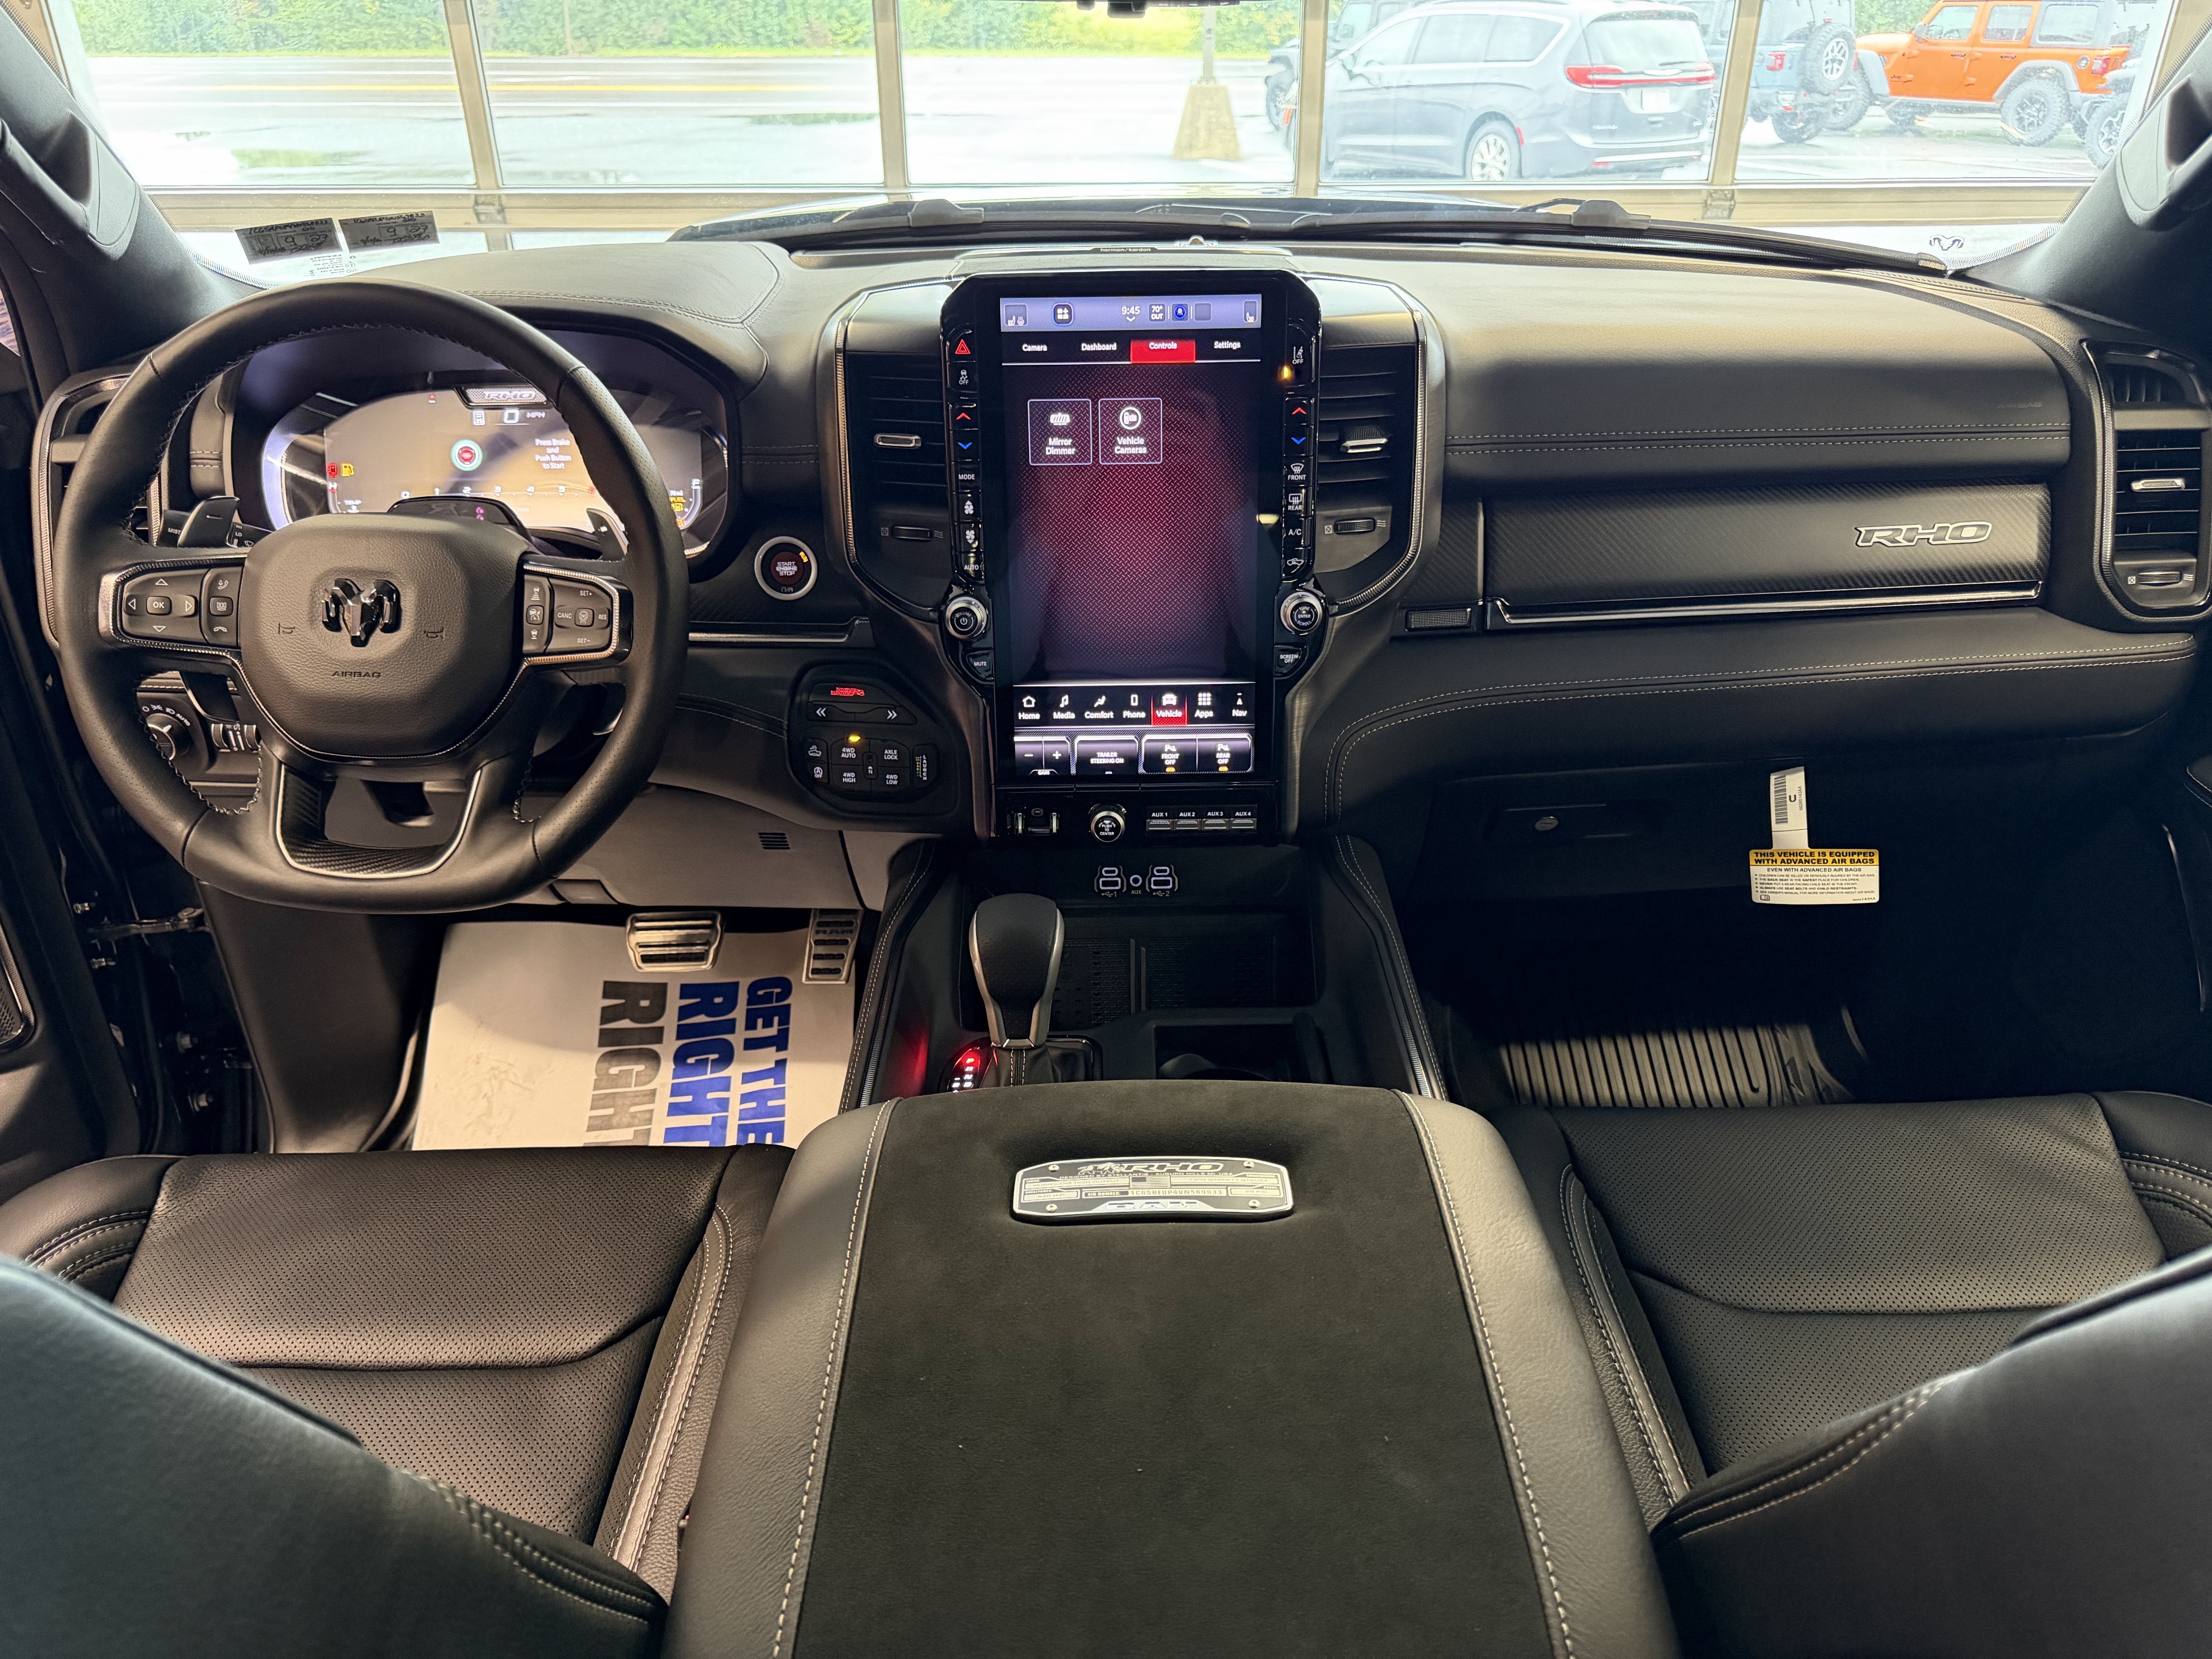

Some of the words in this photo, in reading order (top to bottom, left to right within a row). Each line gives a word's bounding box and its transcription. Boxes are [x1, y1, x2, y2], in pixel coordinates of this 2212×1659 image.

[1121, 306, 1140, 315] 9:45
[1022, 343, 1047, 352] Camera
[1081, 343, 1116, 351] Dashboard
[1149, 341, 1177, 350] Controls
[1214, 340, 1241, 350] Settings
[484, 391, 536, 400] RHO
[1049, 438, 1072, 446] Mirror
[1117, 436, 1144, 445] Vehicle
[1046, 447, 1075, 455] Dimmer
[1114, 446, 1147, 454] Cameras
[1855, 521, 1992, 547] RHO
[176, 713, 191, 726] AUTO
[1018, 712, 1040, 720] Home
[1194, 710, 1213, 718] Apps
[1789, 794, 1796, 802] U
[747, 976, 793, 1052] GET
[663, 981, 740, 1147] RIGHT
[737, 1058, 787, 1145] THE
[1122, 1162, 1224, 1172] RHO
